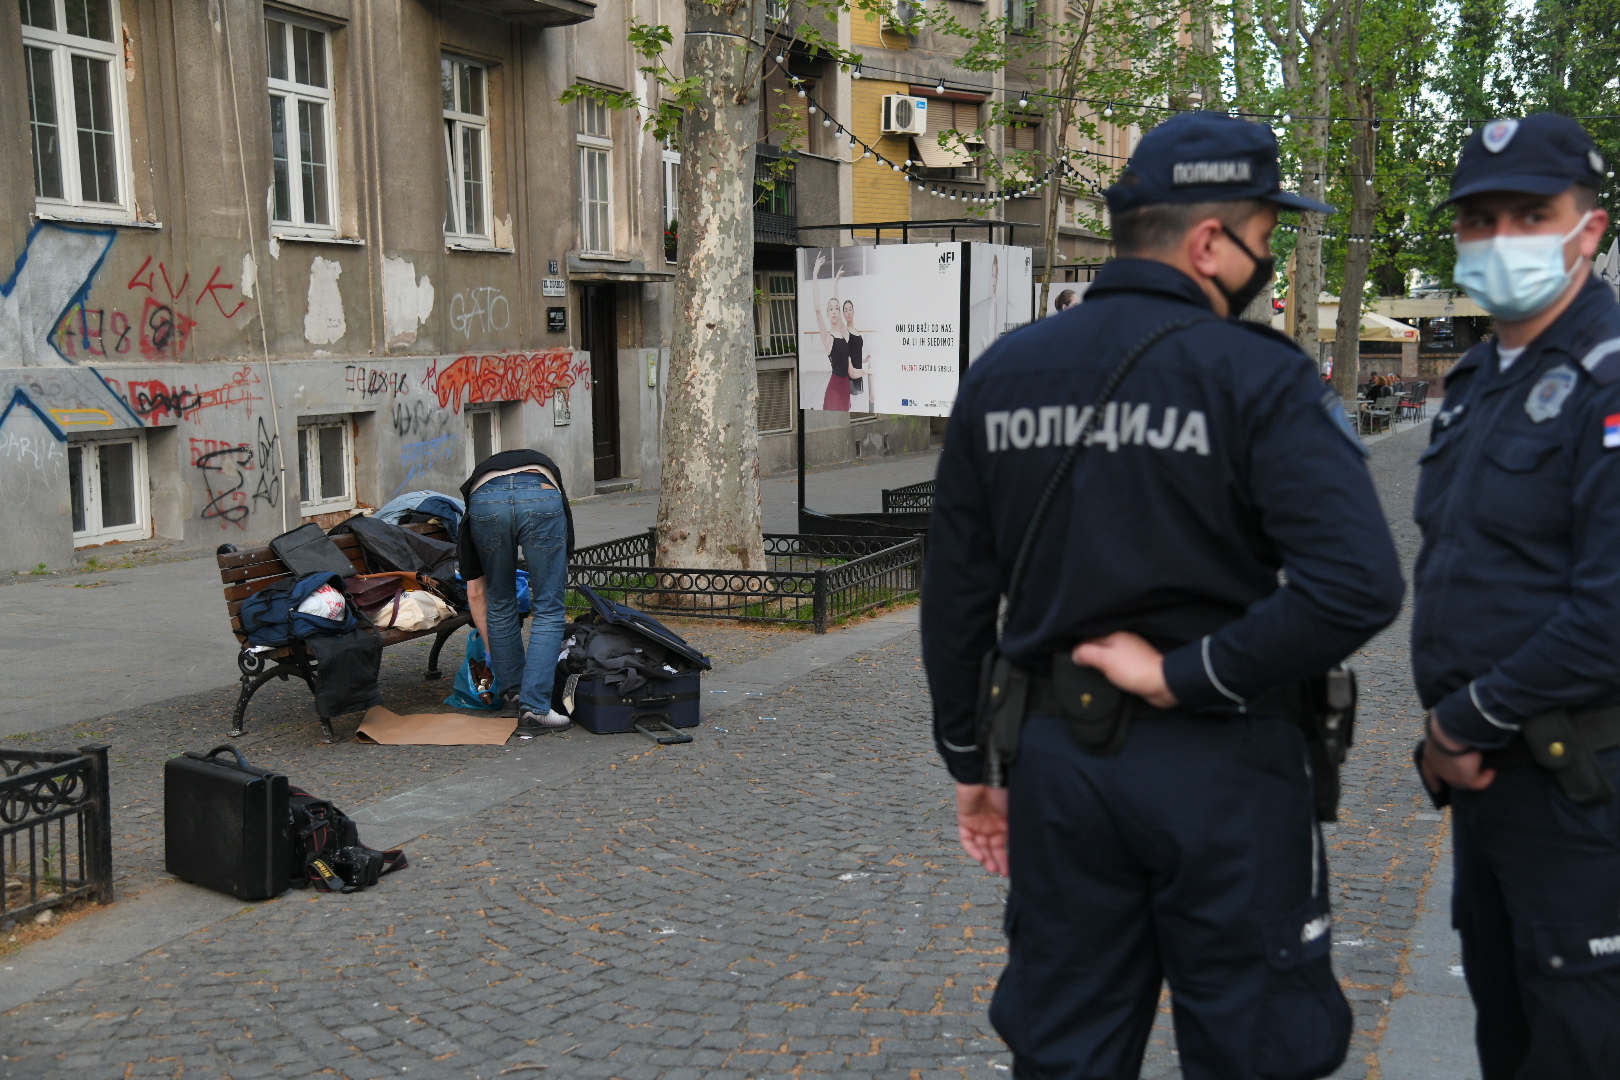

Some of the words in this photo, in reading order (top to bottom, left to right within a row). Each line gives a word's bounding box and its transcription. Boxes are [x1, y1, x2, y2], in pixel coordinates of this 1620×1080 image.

[895, 323, 906, 333] ONI
[907, 323, 915, 333] SU
[902, 337, 910, 346] DA
[985, 402, 1210, 455] ПОЛИЦИЈА
